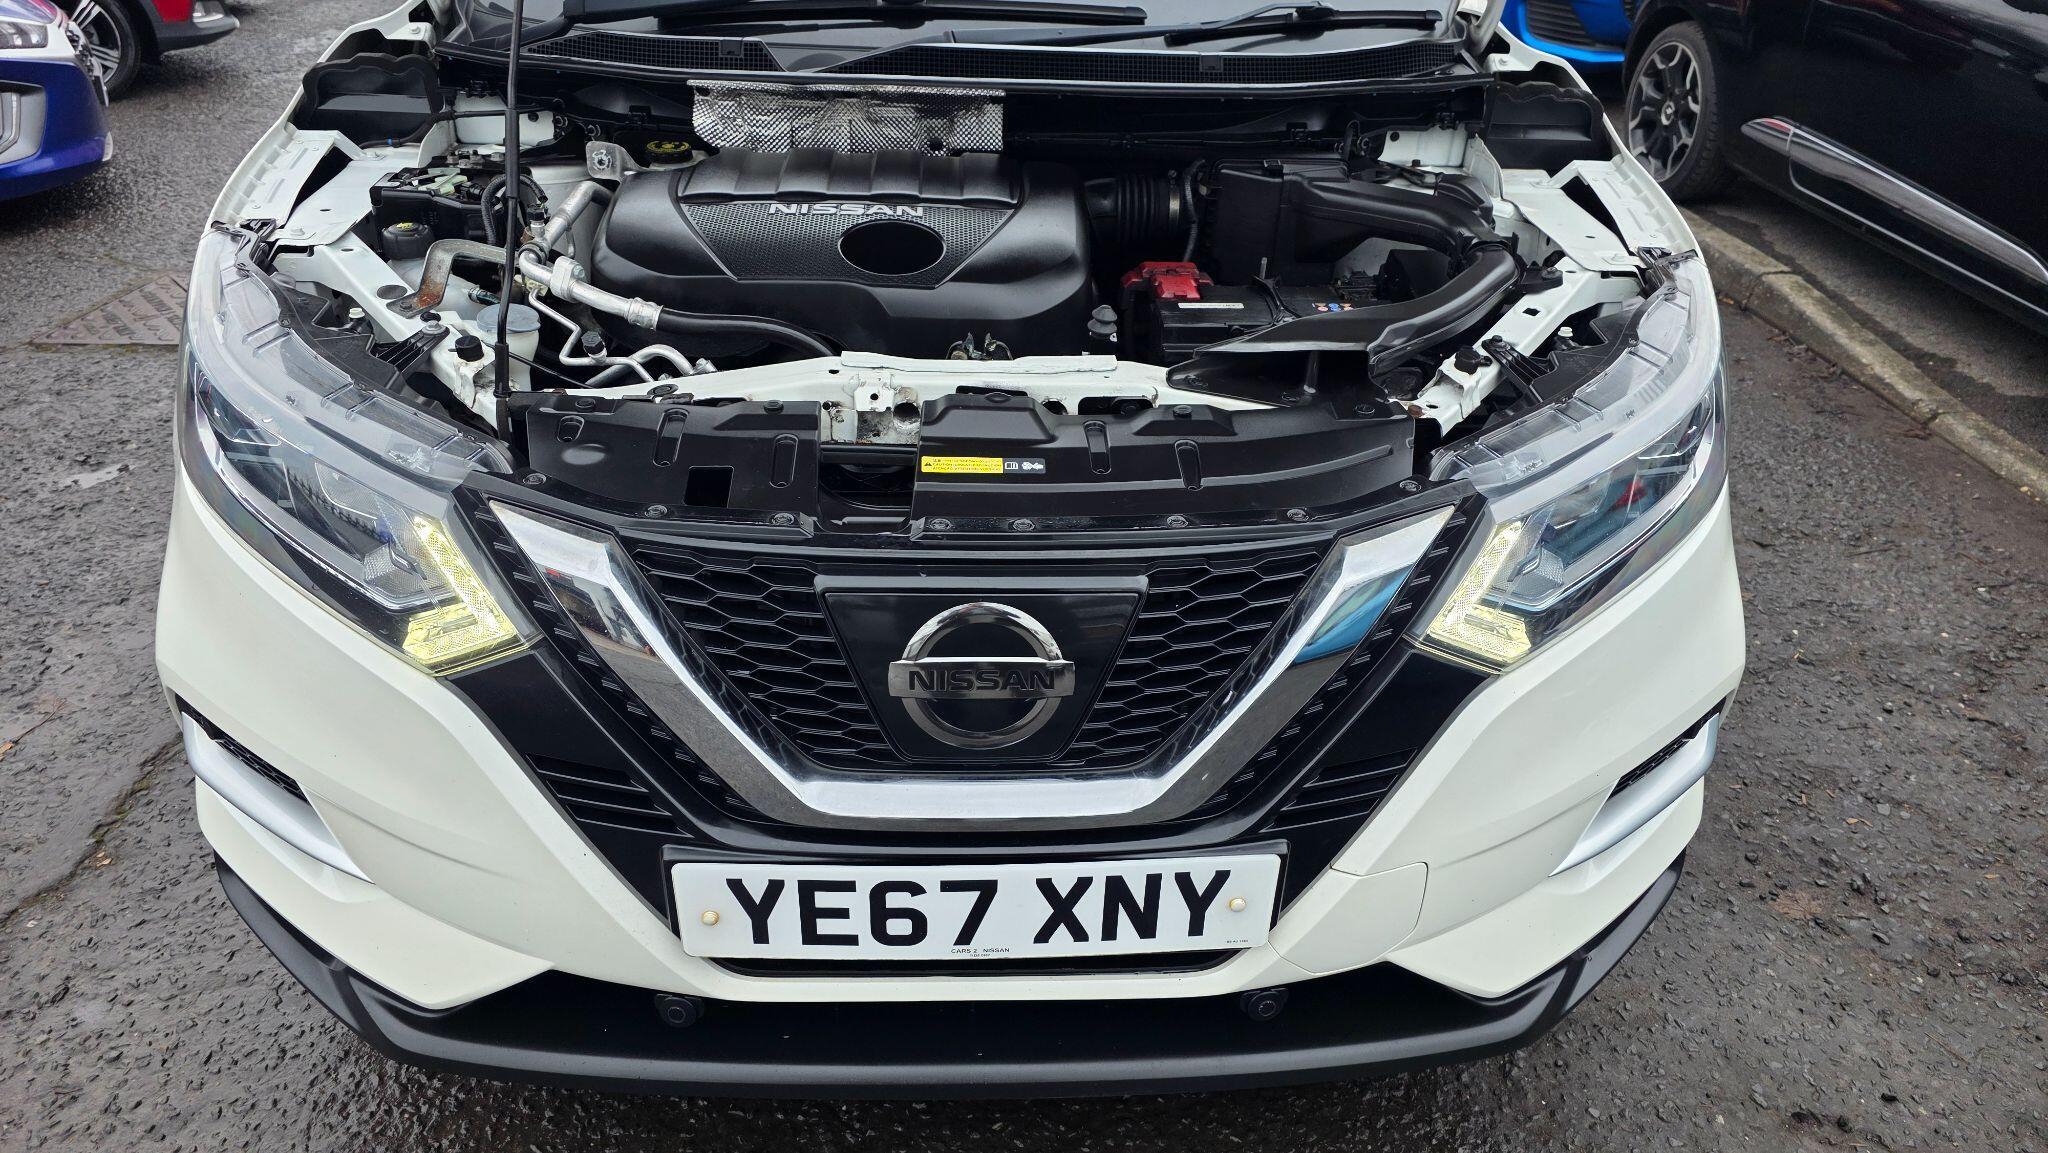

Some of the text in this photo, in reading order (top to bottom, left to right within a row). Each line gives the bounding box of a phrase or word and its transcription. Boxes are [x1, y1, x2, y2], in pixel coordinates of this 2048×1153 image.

[769, 203, 924, 217] NISSAN
[908, 670, 1055, 691] NISSAN
[725, 869, 1232, 947] YE67 XNY
